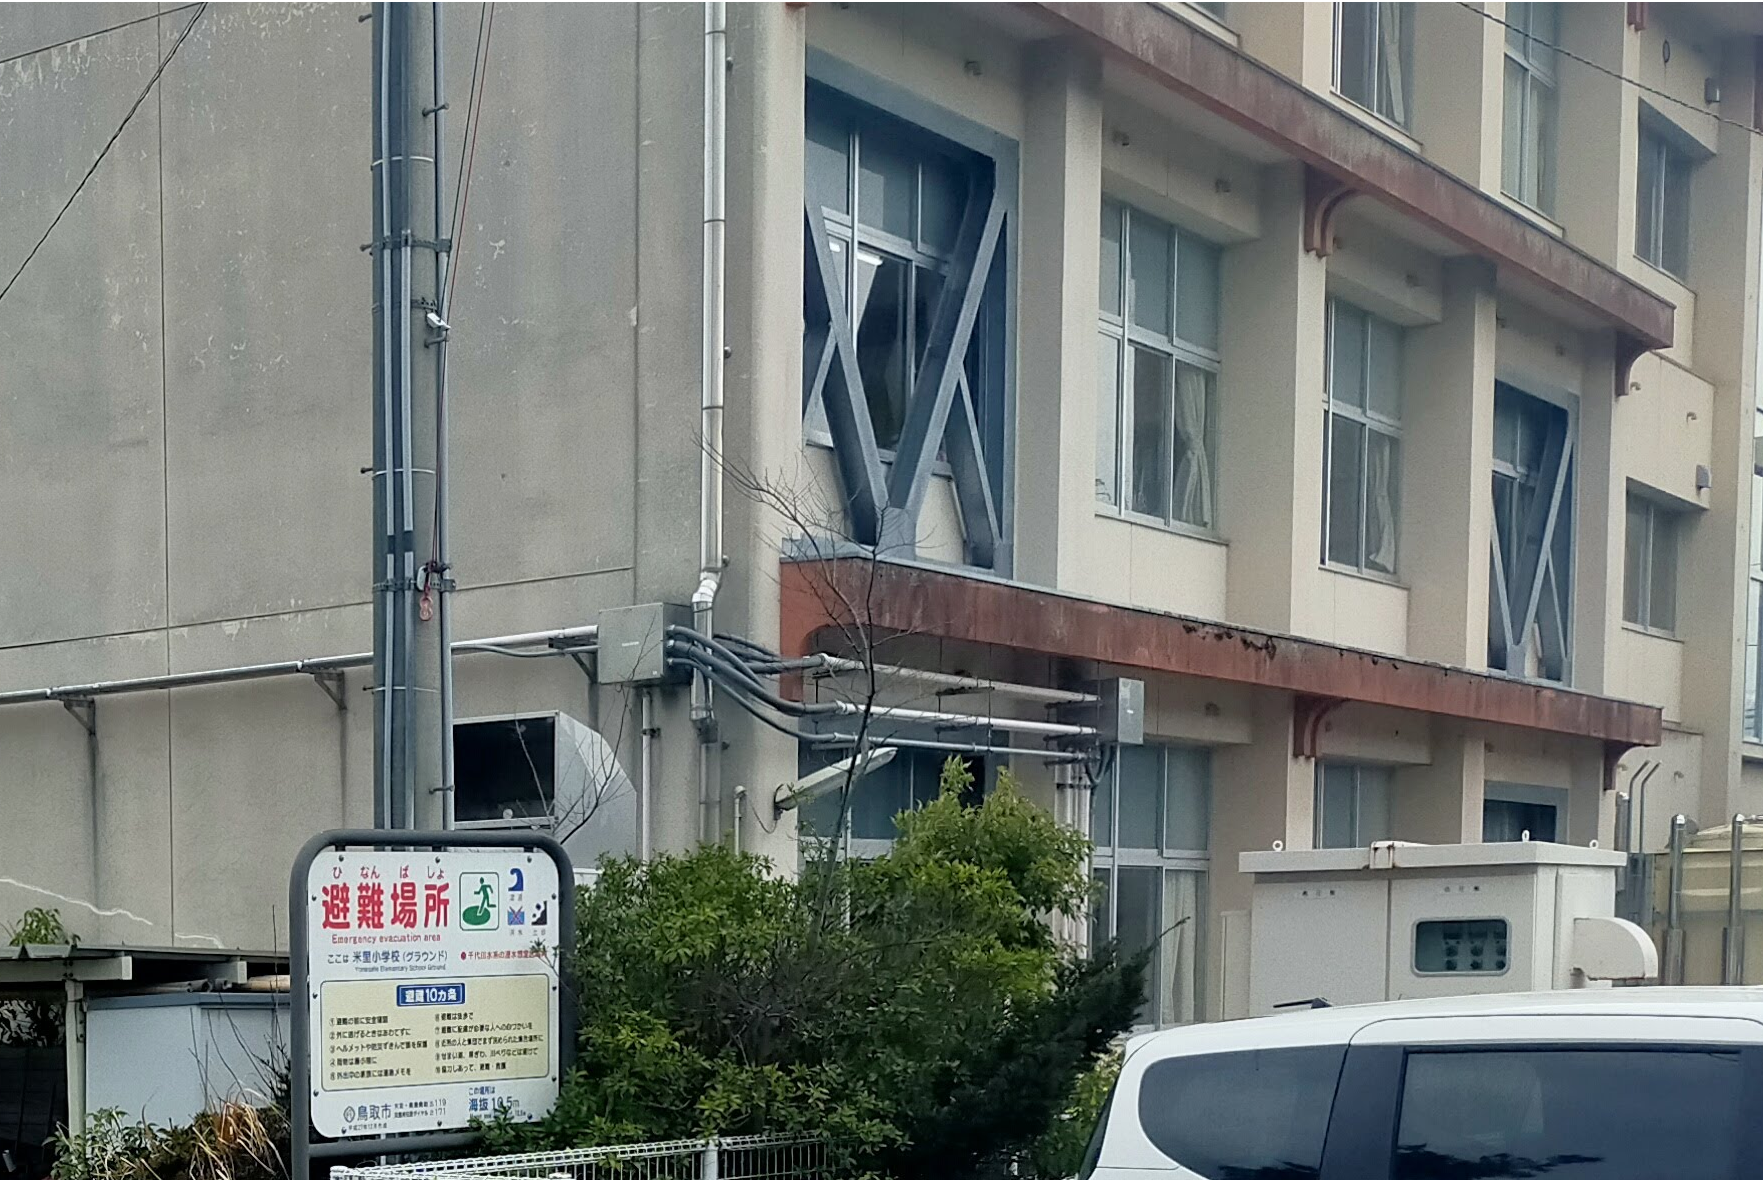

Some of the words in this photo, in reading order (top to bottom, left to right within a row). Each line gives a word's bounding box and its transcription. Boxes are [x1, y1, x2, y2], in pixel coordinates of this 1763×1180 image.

[332, 866, 343, 879] ひ
[360, 866, 380, 879] なん
[400, 865, 409, 879] ば
[427, 865, 445, 880] しょ
[321, 881, 450, 929] 避難場所
[332, 934, 377, 944] Emergency
[379, 933, 422, 943] evacuation
[424, 934, 441, 942] area
[327, 953, 349, 964] ここは
[491, 1096, 520, 1112] 105m
[357, 1103, 392, 1121] 鳥取市
